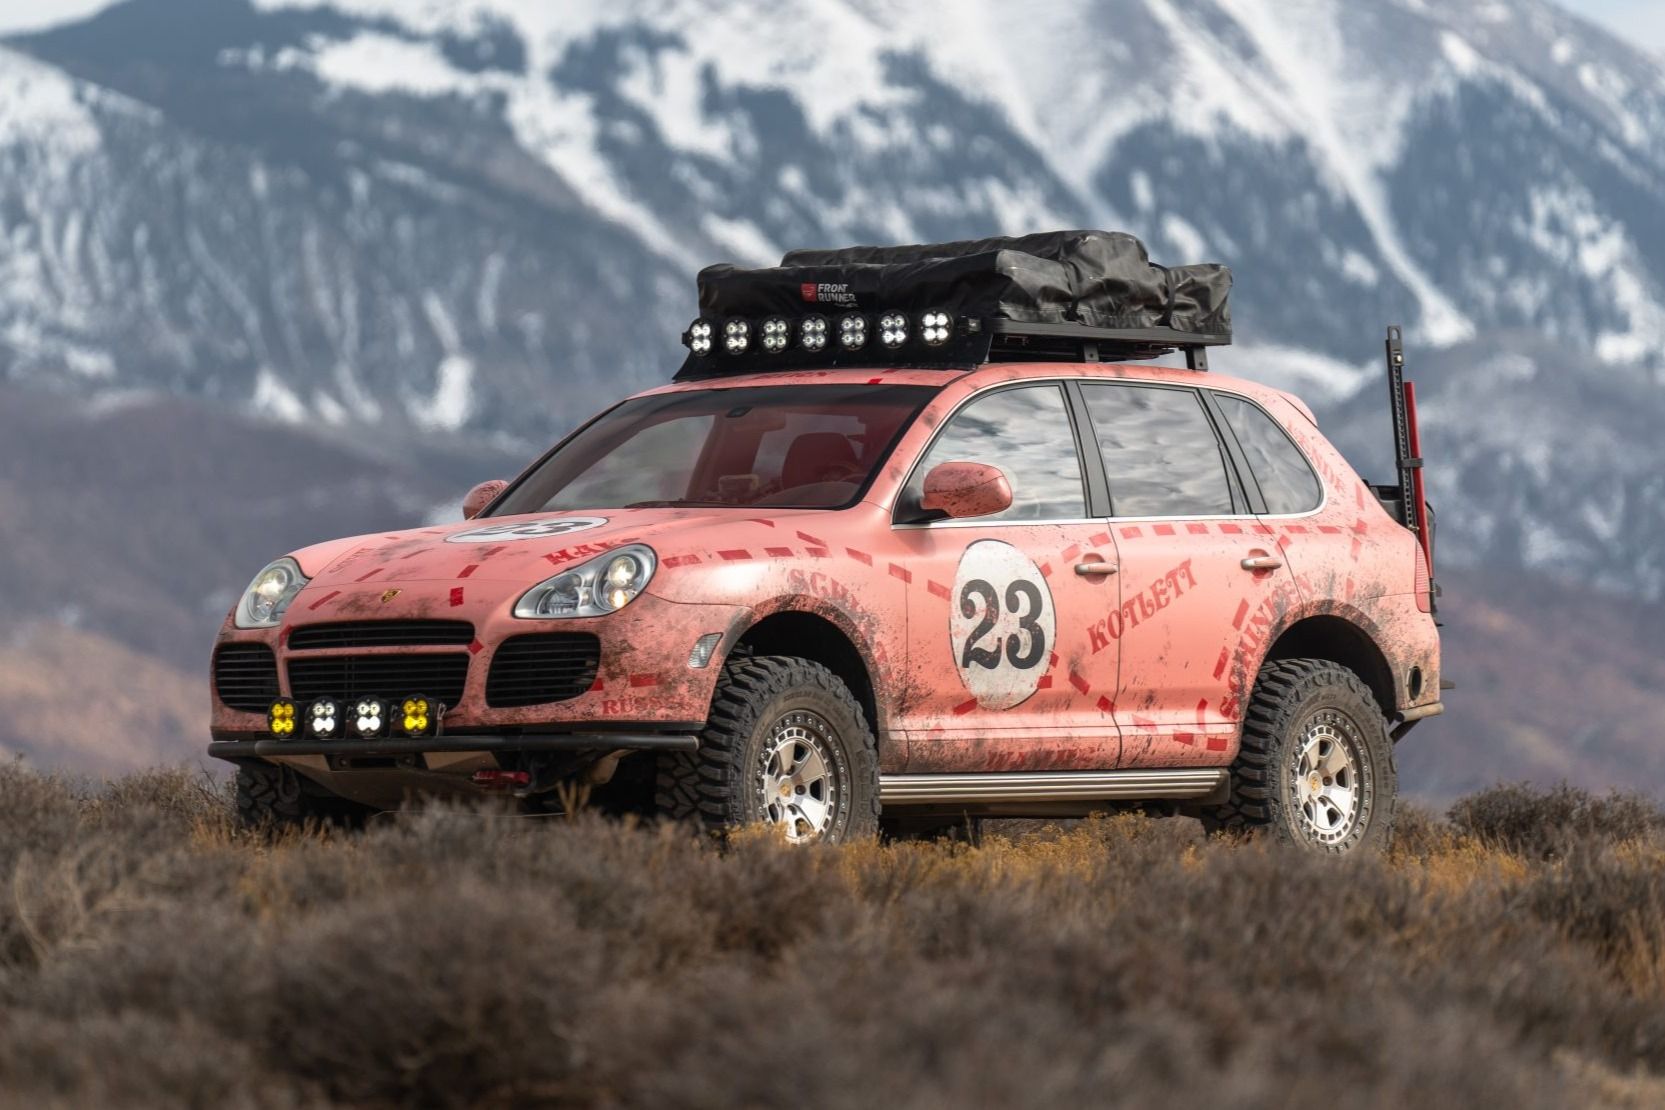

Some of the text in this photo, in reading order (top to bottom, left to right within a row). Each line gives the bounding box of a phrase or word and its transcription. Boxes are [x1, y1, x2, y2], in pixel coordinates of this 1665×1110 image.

[817, 283, 848, 293] FRONT
[817, 293, 857, 302] RUNNER
[959, 579, 1046, 670] 23
[1086, 558, 1198, 655] KOTLETT
